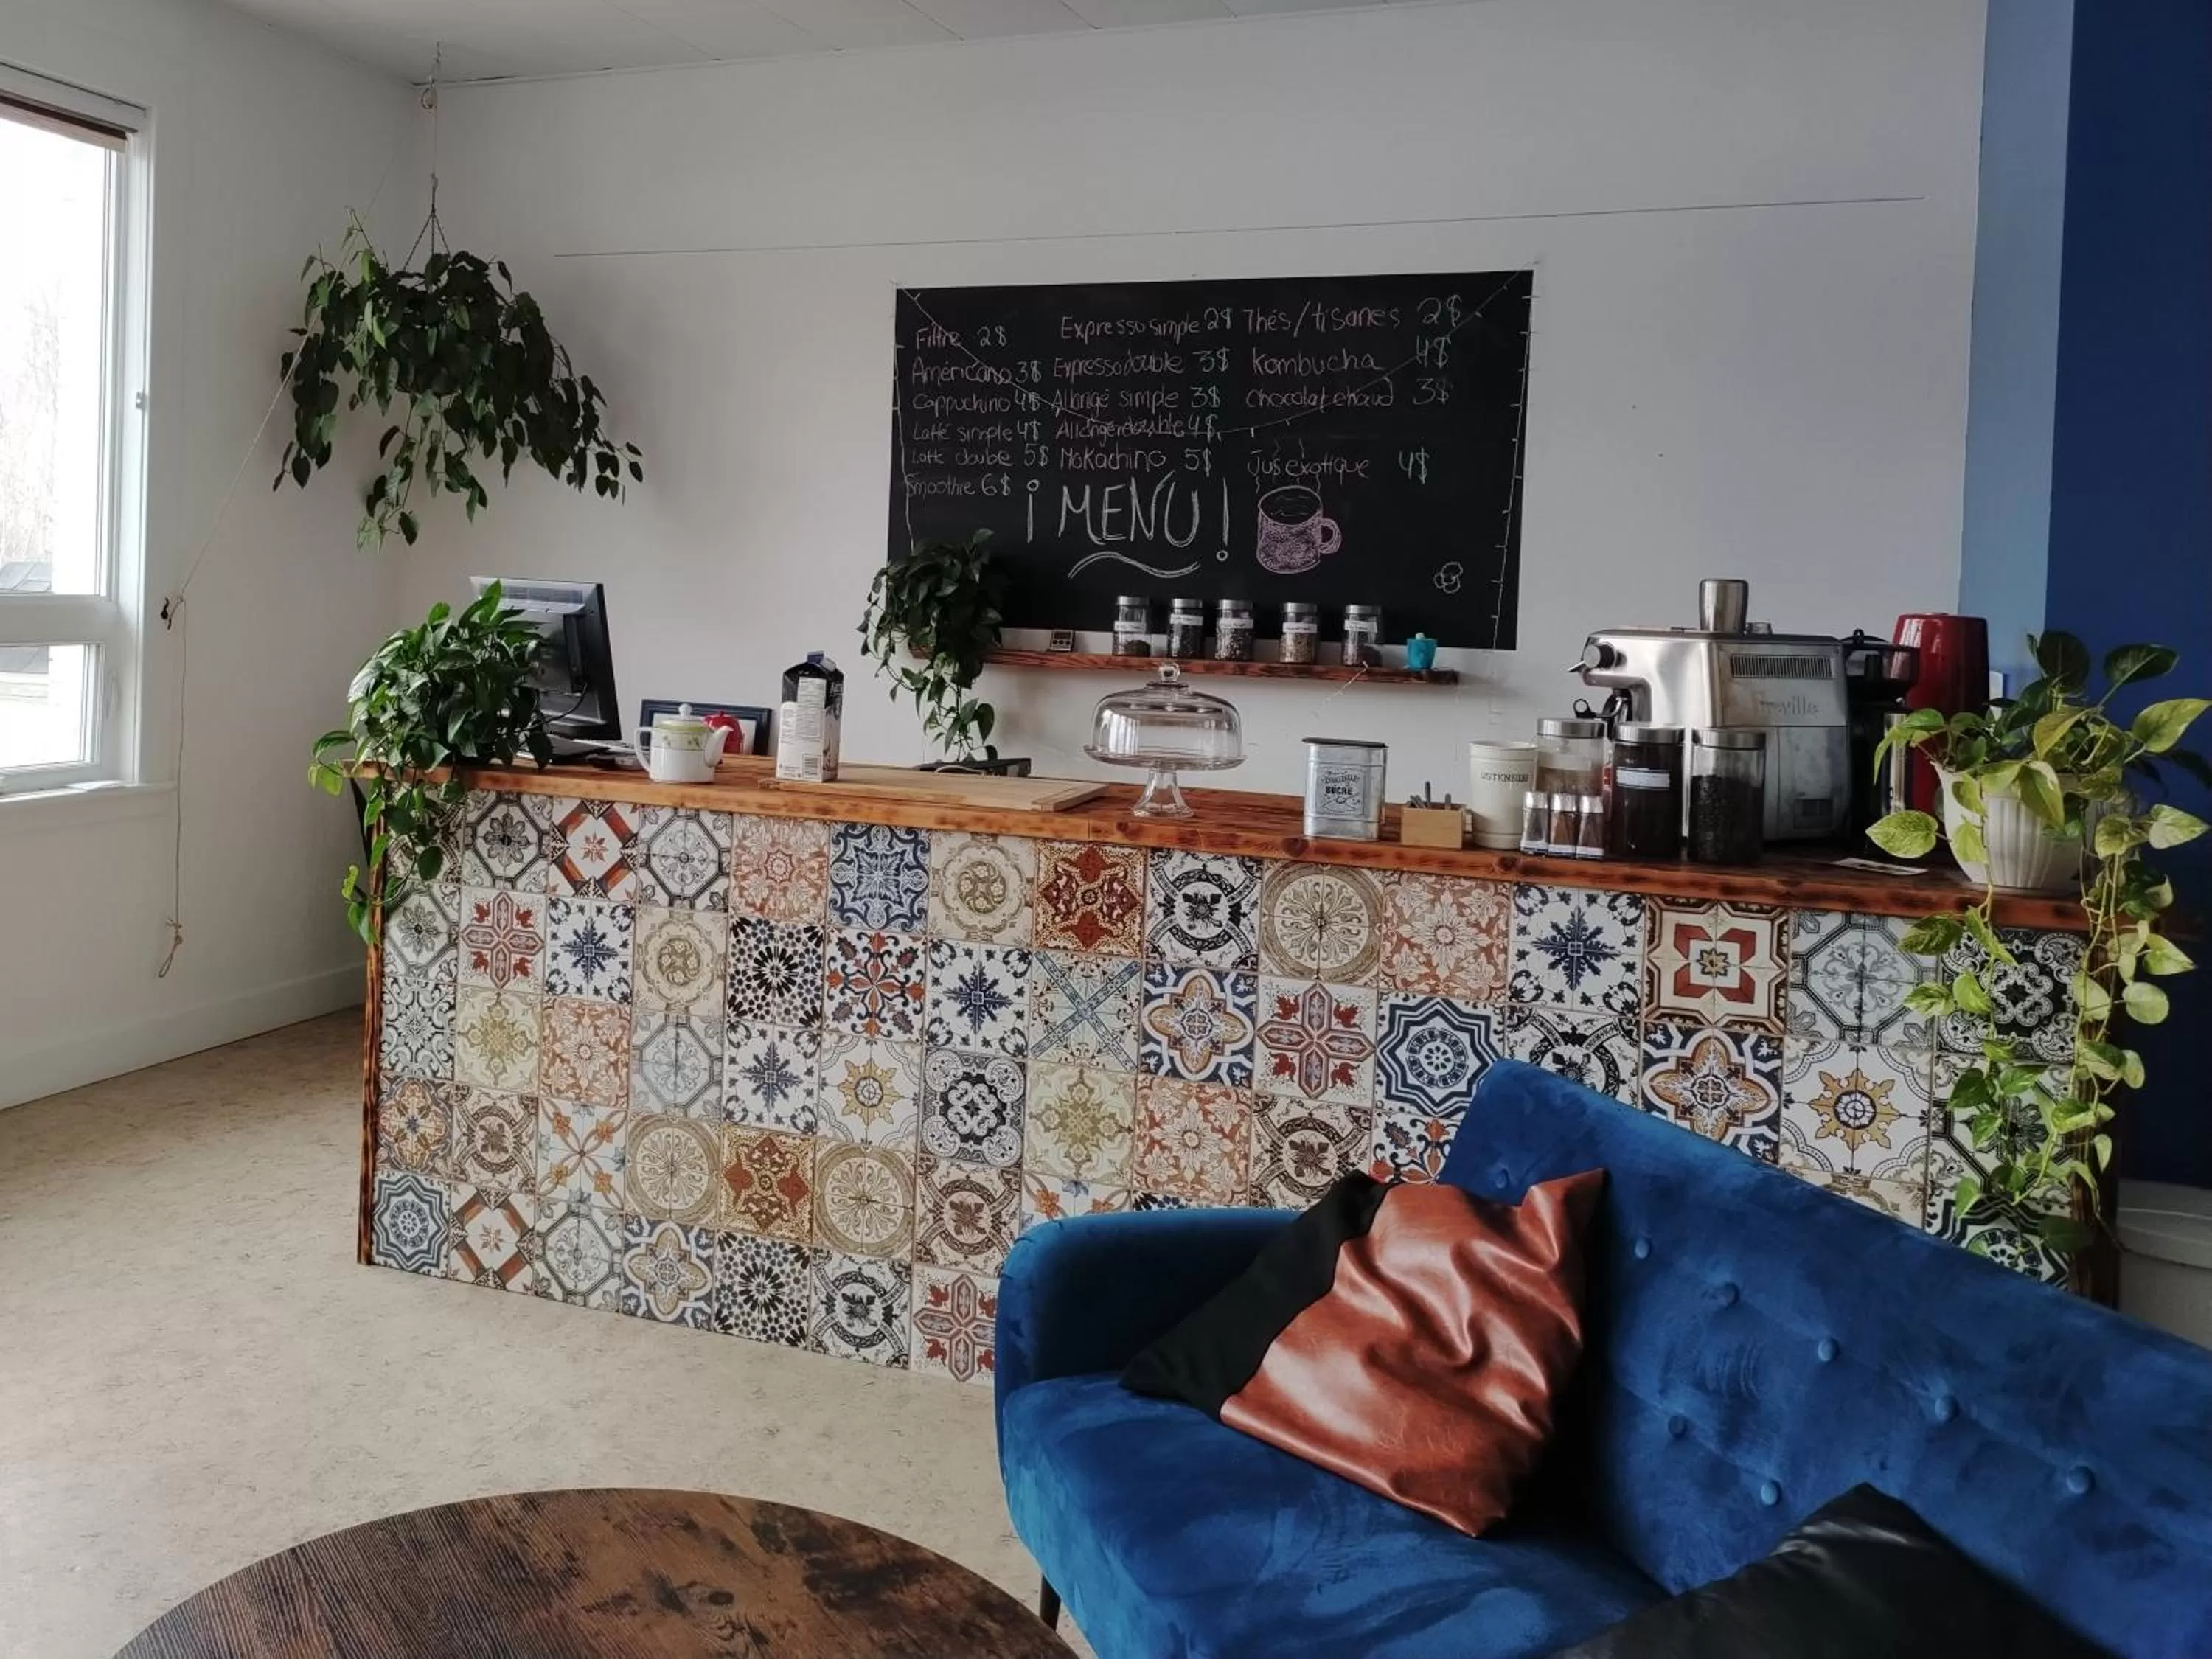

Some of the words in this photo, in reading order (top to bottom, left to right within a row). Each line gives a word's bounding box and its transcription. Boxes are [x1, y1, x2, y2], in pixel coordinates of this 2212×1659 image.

[1417, 295, 1462, 328] 2$
[1189, 386, 1220, 408] 3$
[1058, 470, 1200, 547] MENU
